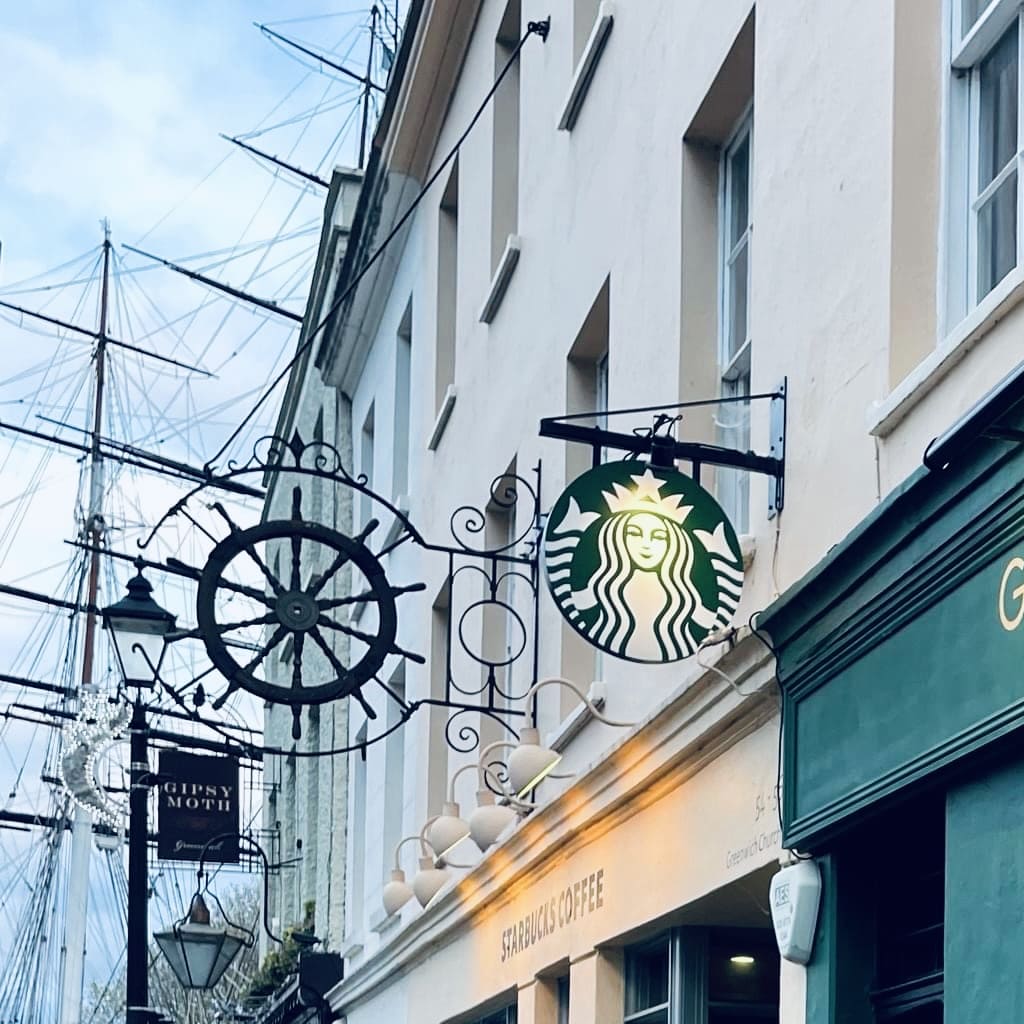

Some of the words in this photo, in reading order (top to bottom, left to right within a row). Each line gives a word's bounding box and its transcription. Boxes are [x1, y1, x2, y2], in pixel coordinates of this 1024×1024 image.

[164, 782, 232, 798] GIPSY
[167, 796, 230, 812] MOTH
[501, 897, 556, 962] STARBUCKS
[559, 868, 604, 928] COFFEE
